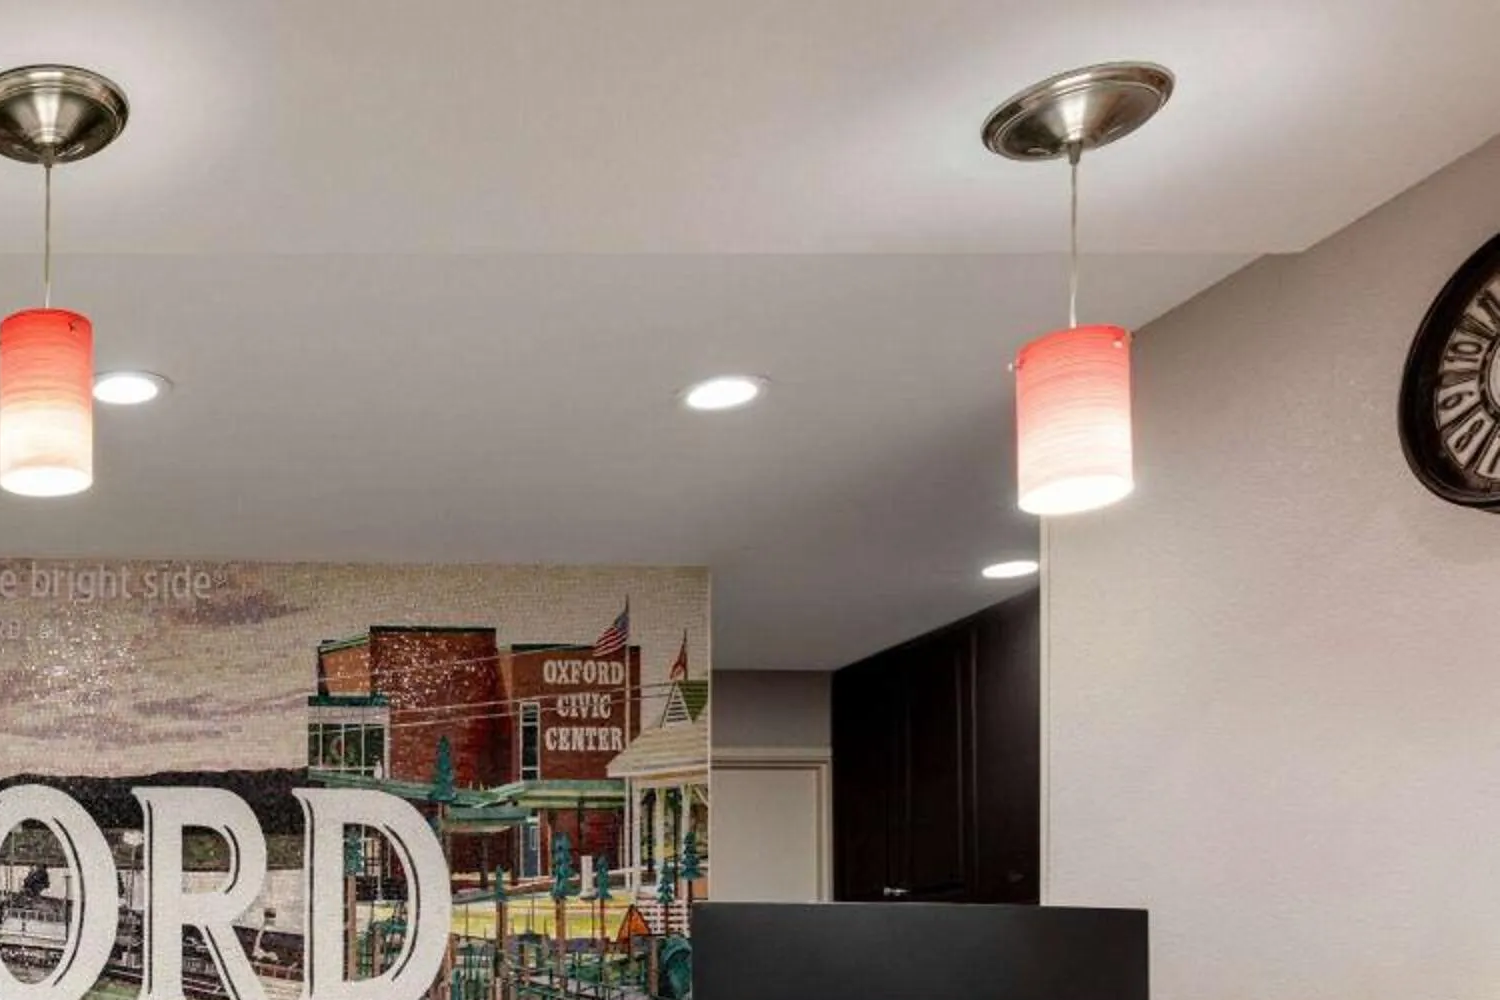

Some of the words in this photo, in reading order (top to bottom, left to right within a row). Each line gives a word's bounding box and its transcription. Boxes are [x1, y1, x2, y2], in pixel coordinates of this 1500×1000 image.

[30, 560, 133, 603] bright
[543, 659, 624, 685] OXFORD
[556, 692, 612, 719] CIVIC
[545, 726, 622, 751] CENTER
